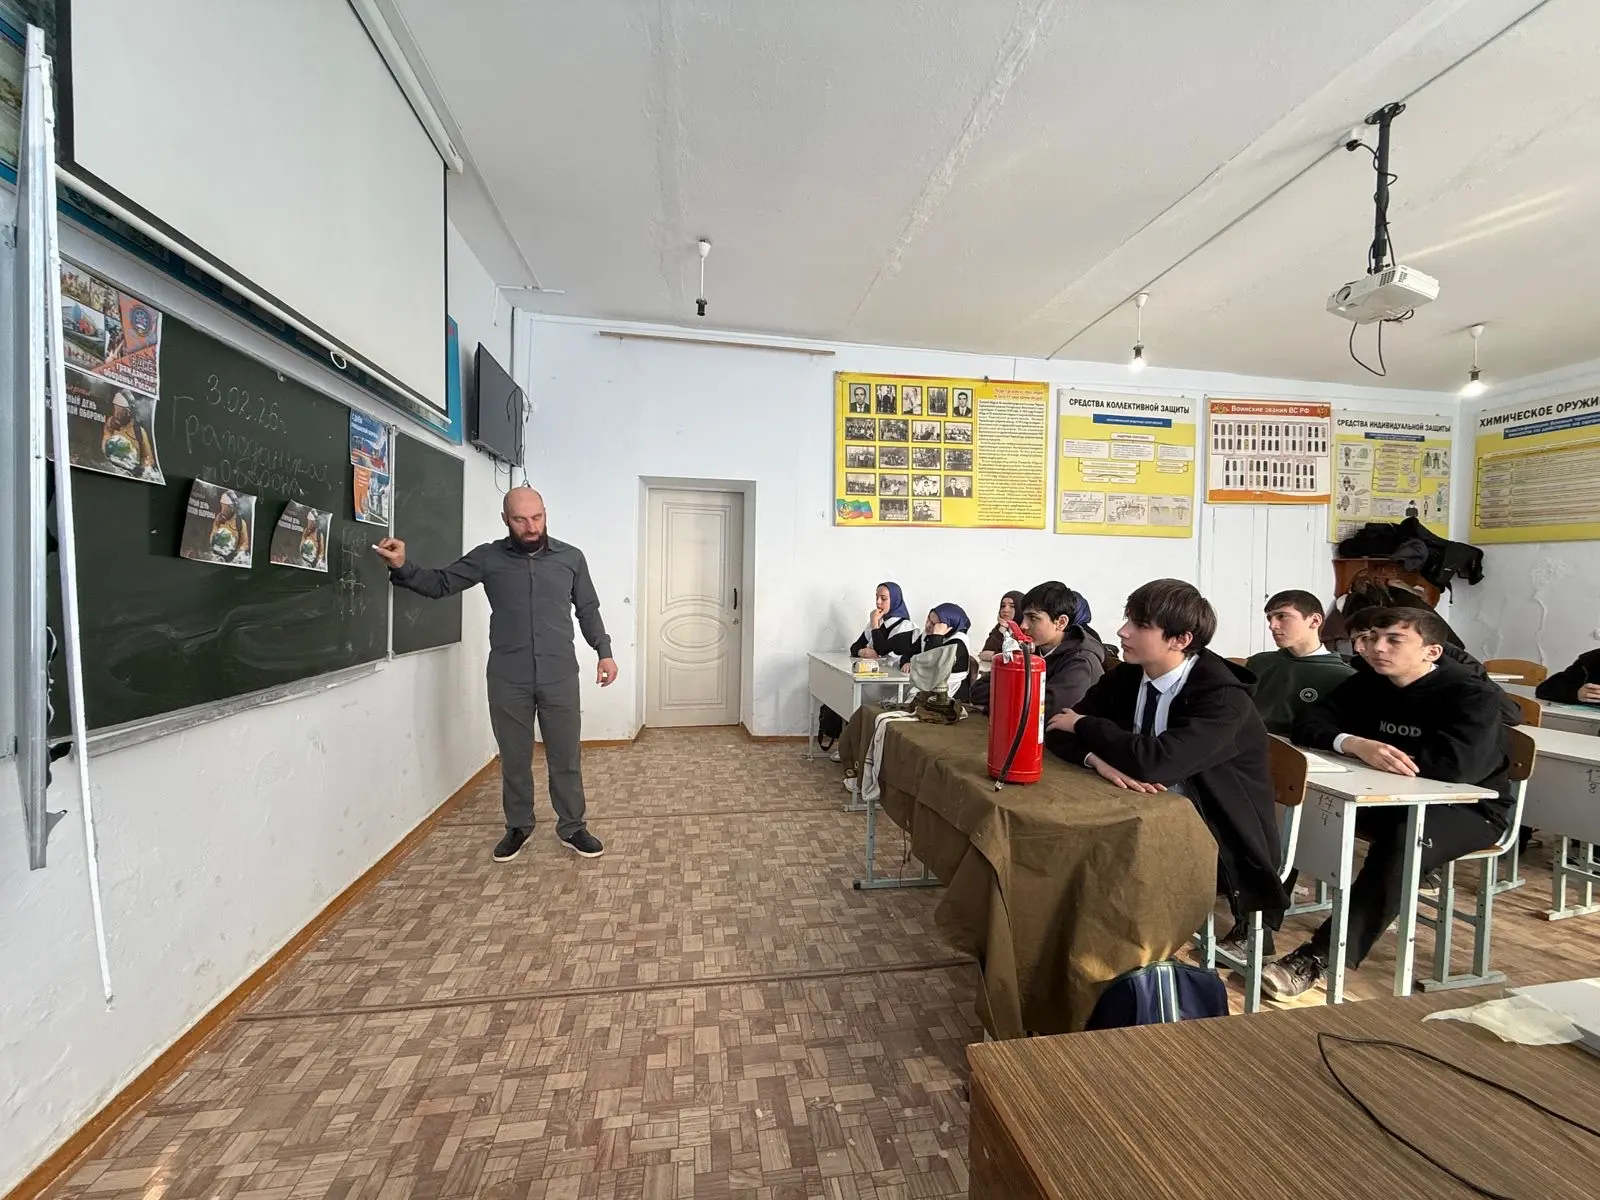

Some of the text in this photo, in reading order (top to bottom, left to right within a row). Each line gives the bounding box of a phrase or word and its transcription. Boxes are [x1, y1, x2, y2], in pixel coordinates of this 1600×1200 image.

[1069, 398, 1190, 414] СРЕДСТВА КОЛЛЕКТИВНОЙ ЗАЩИТЫ
[1231, 404, 1264, 413] Воинские
[1289, 406, 1299, 414] ВС
[1479, 405, 1553, 428] ХИМИЧЕСКОЕ
[1336, 419, 1451, 433] СРЕДСТВА ИНДИВИДУАЛЬНОЙ ЗАЩИТЫ
[1589, 783, 1597, 794] 8
